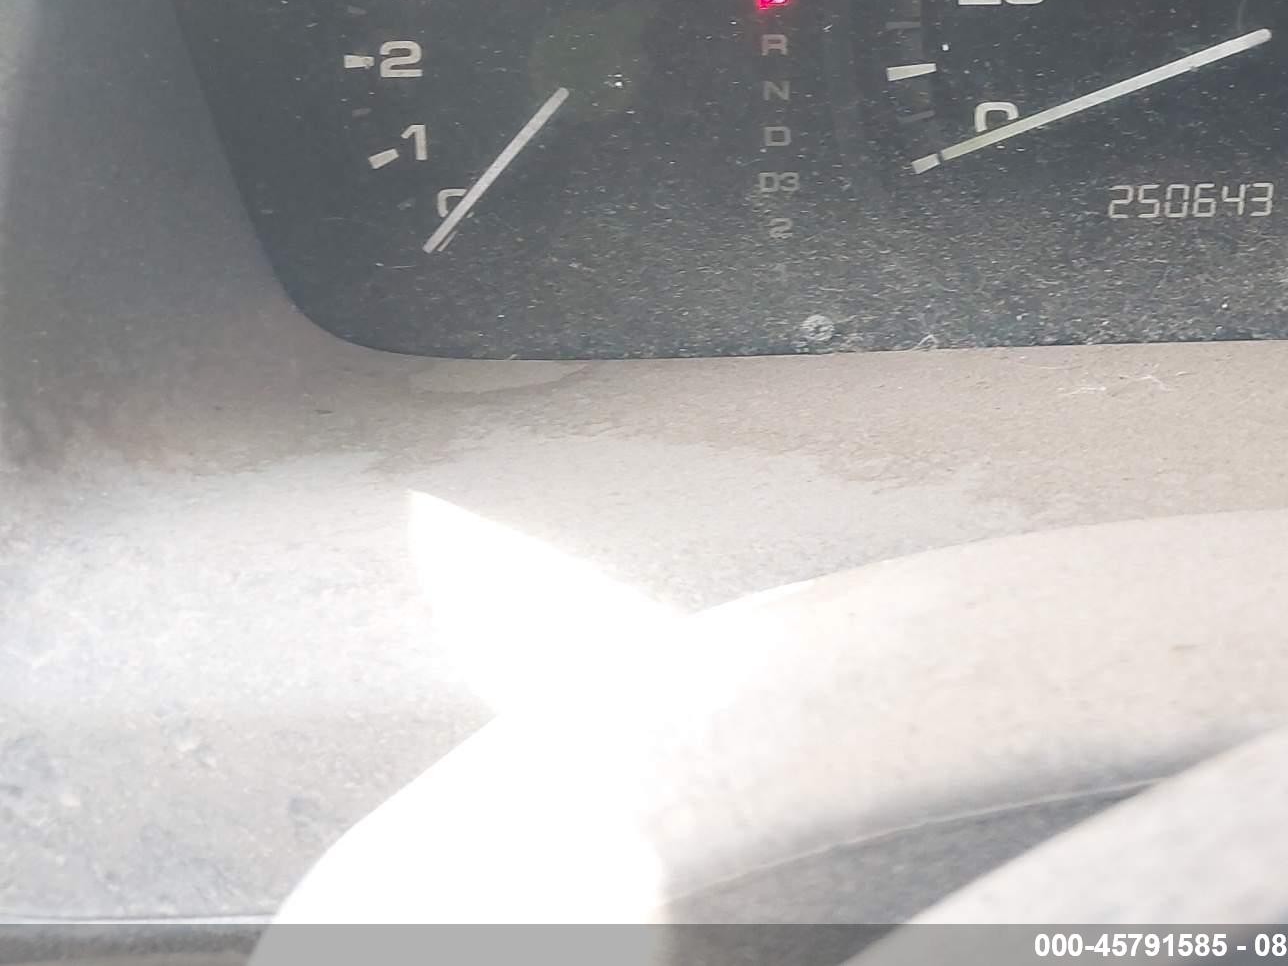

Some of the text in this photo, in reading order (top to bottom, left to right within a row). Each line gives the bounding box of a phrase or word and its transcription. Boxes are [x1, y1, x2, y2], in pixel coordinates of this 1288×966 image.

[761, 35, 789, 56] R
[379, 40, 423, 78] 2
[763, 81, 789, 101] N
[401, 124, 428, 161] 1
[764, 126, 792, 147] D
[759, 172, 799, 192] D3
[1108, 182, 1274, 218] 250643
